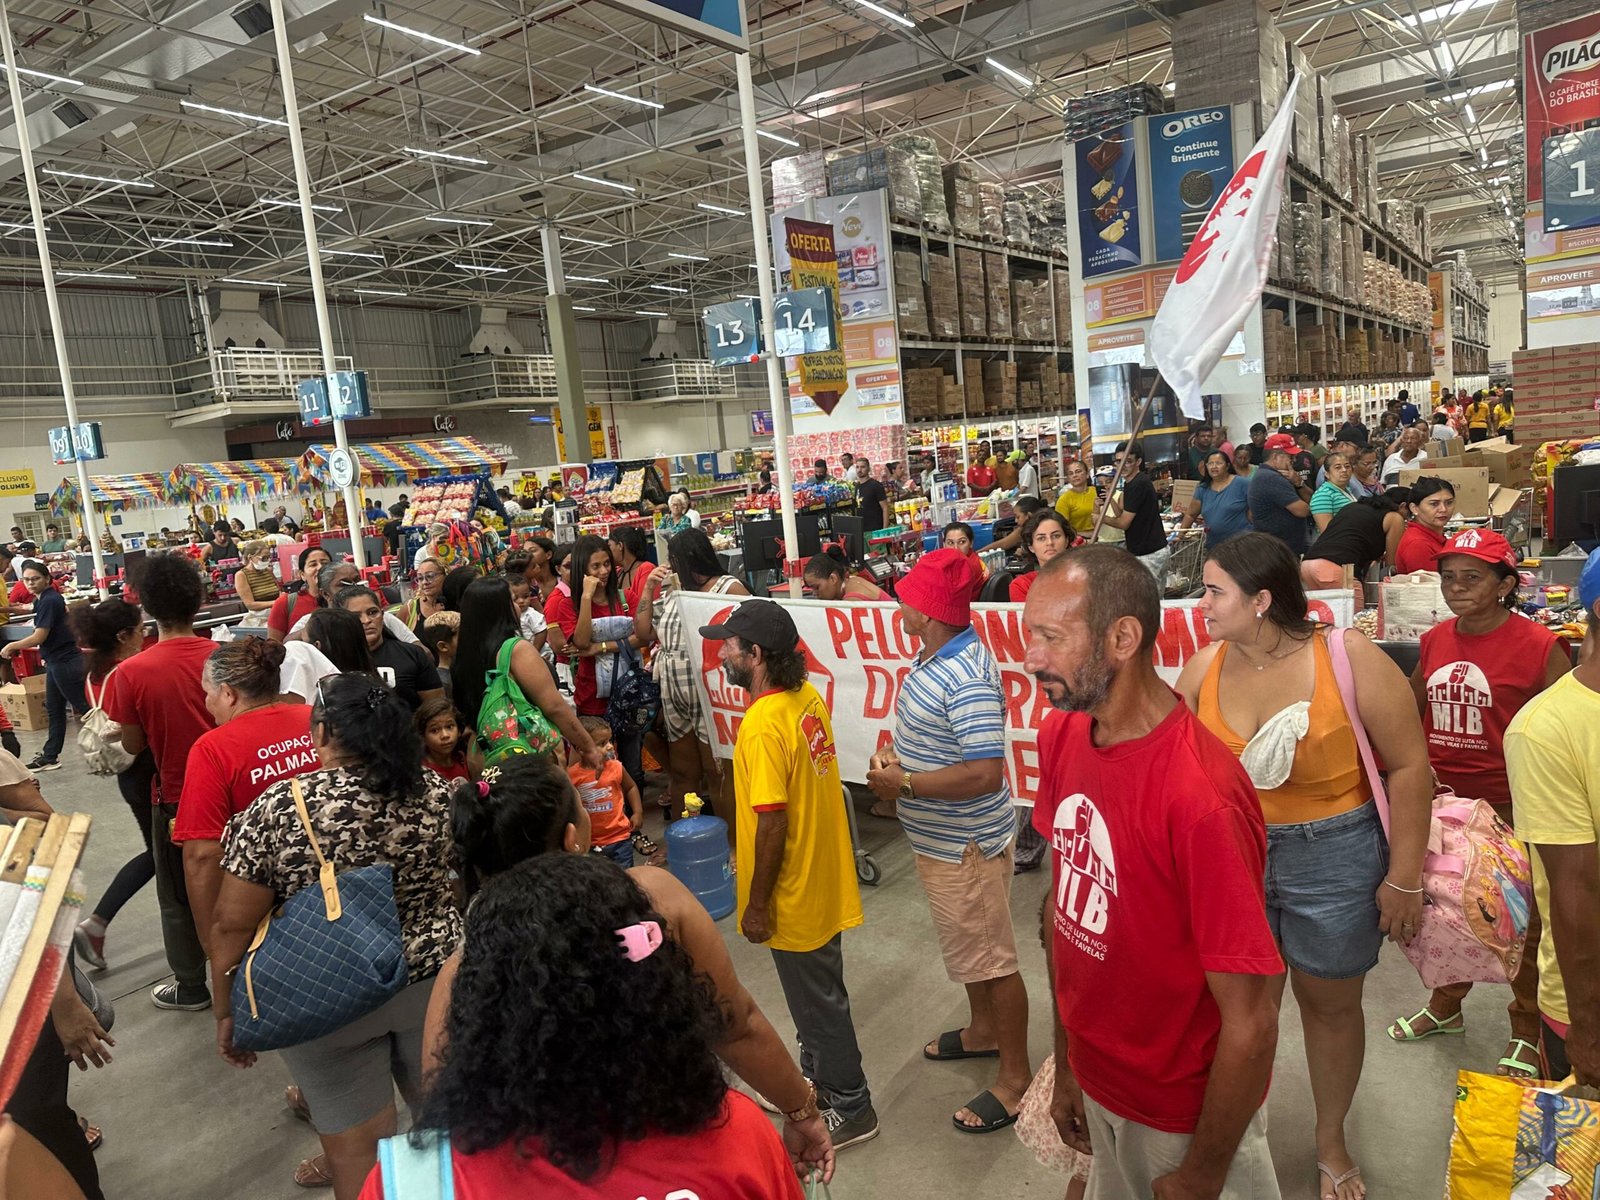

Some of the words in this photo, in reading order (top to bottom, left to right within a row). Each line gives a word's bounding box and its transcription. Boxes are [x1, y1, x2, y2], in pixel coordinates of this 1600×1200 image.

[1557, 84, 1574, 95] CAFÉ
[1576, 79, 1599, 91] FORTE
[1550, 97, 1564, 107] DO
[1566, 88, 1599, 103] BRASIL
[1162, 111, 1224, 138] OREO
[1174, 140, 1218, 153] Continue
[1171, 150, 1220, 163] Brincante
[790, 233, 832, 252] OFERTA
[1088, 250, 1119, 262] PEDACINHO
[1095, 247, 1110, 255] CADA
[1090, 257, 1118, 268] APROXIMA
[1540, 270, 1594, 284] APROVEITE
[1087, 300, 1100, 312] 08
[783, 308, 815, 335] 14
[715, 319, 745, 347] 13
[1097, 334, 1135, 345] APROVEITE
[877, 337, 893, 348] 08
[302, 393, 319, 412] 11
[276, 421, 294, 440] Café
[434, 414, 455, 432] Café
[53, 439, 65, 453] 09
[76, 434, 89, 449] 10
[494, 445, 513, 455] café
[1455, 540, 1477, 548] MLB
[1431, 702, 1483, 735] MLB
[250, 749, 319, 784] PALMAR
[1058, 926, 1071, 940] VILAS
[1074, 938, 1105, 961] FAVELAS
[1066, 921, 1074, 932] DE
[1073, 926, 1090, 943] LUTA
[1090, 936, 1108, 953] NOS
